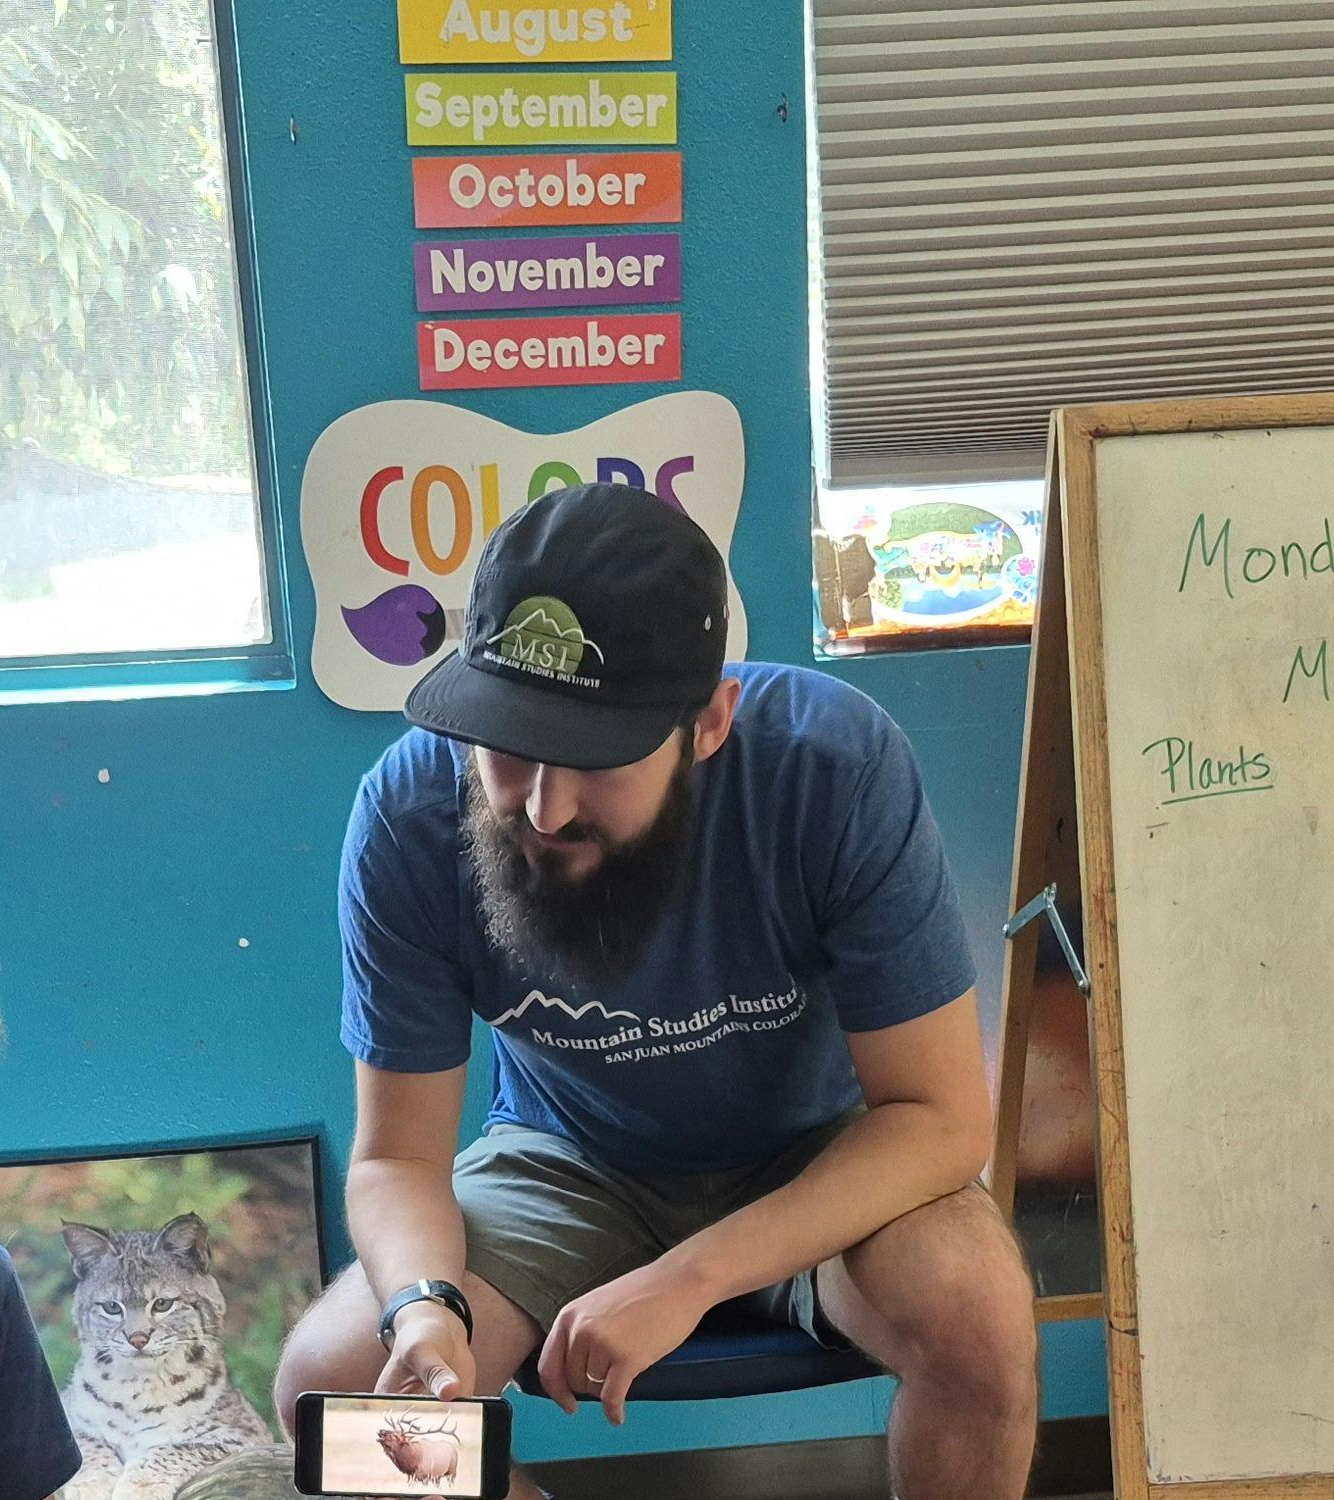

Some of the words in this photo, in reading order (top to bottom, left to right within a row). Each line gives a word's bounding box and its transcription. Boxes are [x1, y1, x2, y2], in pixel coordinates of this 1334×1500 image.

[439, 0, 633, 56] August
[415, 79, 667, 141] September
[449, 158, 646, 209] October
[430, 242, 665, 295] November
[434, 321, 666, 374] December
[512, 633, 571, 671] MSI
[521, 662, 555, 679] STUDIES
[557, 671, 601, 688] INSTITUTE
[1143, 737, 1270, 792] Plants
[531, 1025, 643, 1051] Mountain
[649, 1001, 727, 1037] Studies
[605, 1051, 632, 1063] SAN
[633, 1045, 671, 1062] JUAN
[673, 1021, 751, 1054] MOUNTAINS
